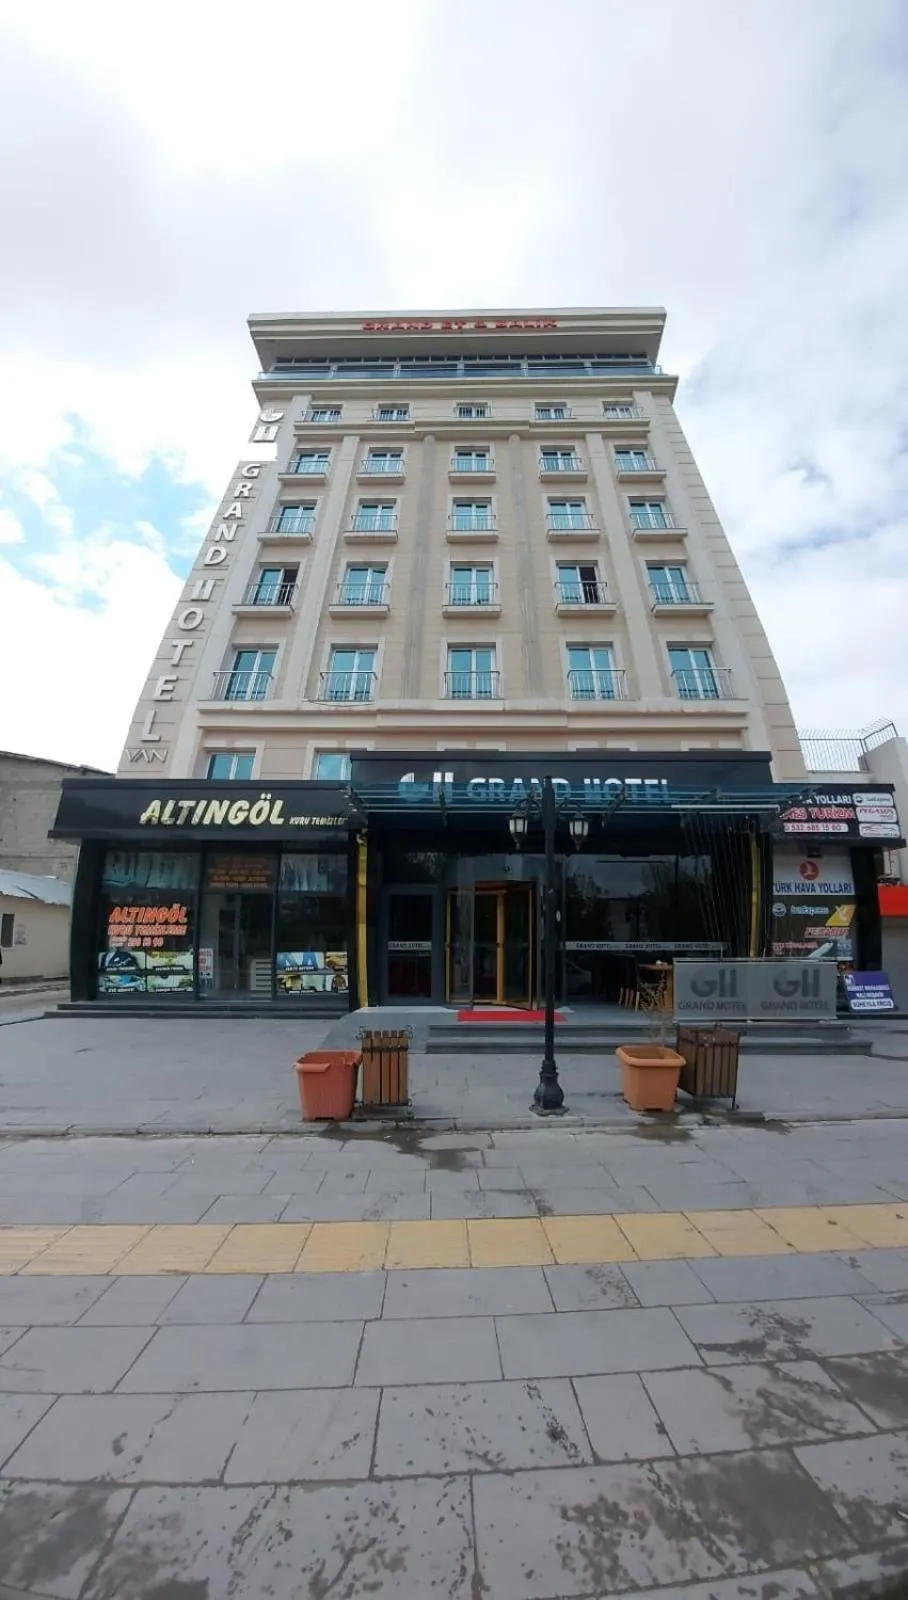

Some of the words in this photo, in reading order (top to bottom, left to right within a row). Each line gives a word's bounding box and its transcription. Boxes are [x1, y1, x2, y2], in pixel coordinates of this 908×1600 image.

[362, 320, 433, 331] GRAND
[204, 463, 262, 567] GRAND
[140, 579, 216, 742] HOTEL
[125, 749, 168, 763] VAN
[466, 777, 570, 803] GRAND
[583, 777, 669, 804] HOTEL
[814, 795, 852, 804] YOLLARI
[139, 793, 285, 825] ALTINGÖL
[289, 816, 310, 825] KURU
[795, 882, 816, 893] HAVA
[818, 882, 852, 893] YOLLARI
[109, 903, 187, 923] ALTINGÖL
[678, 1001, 715, 1011] GRAND
